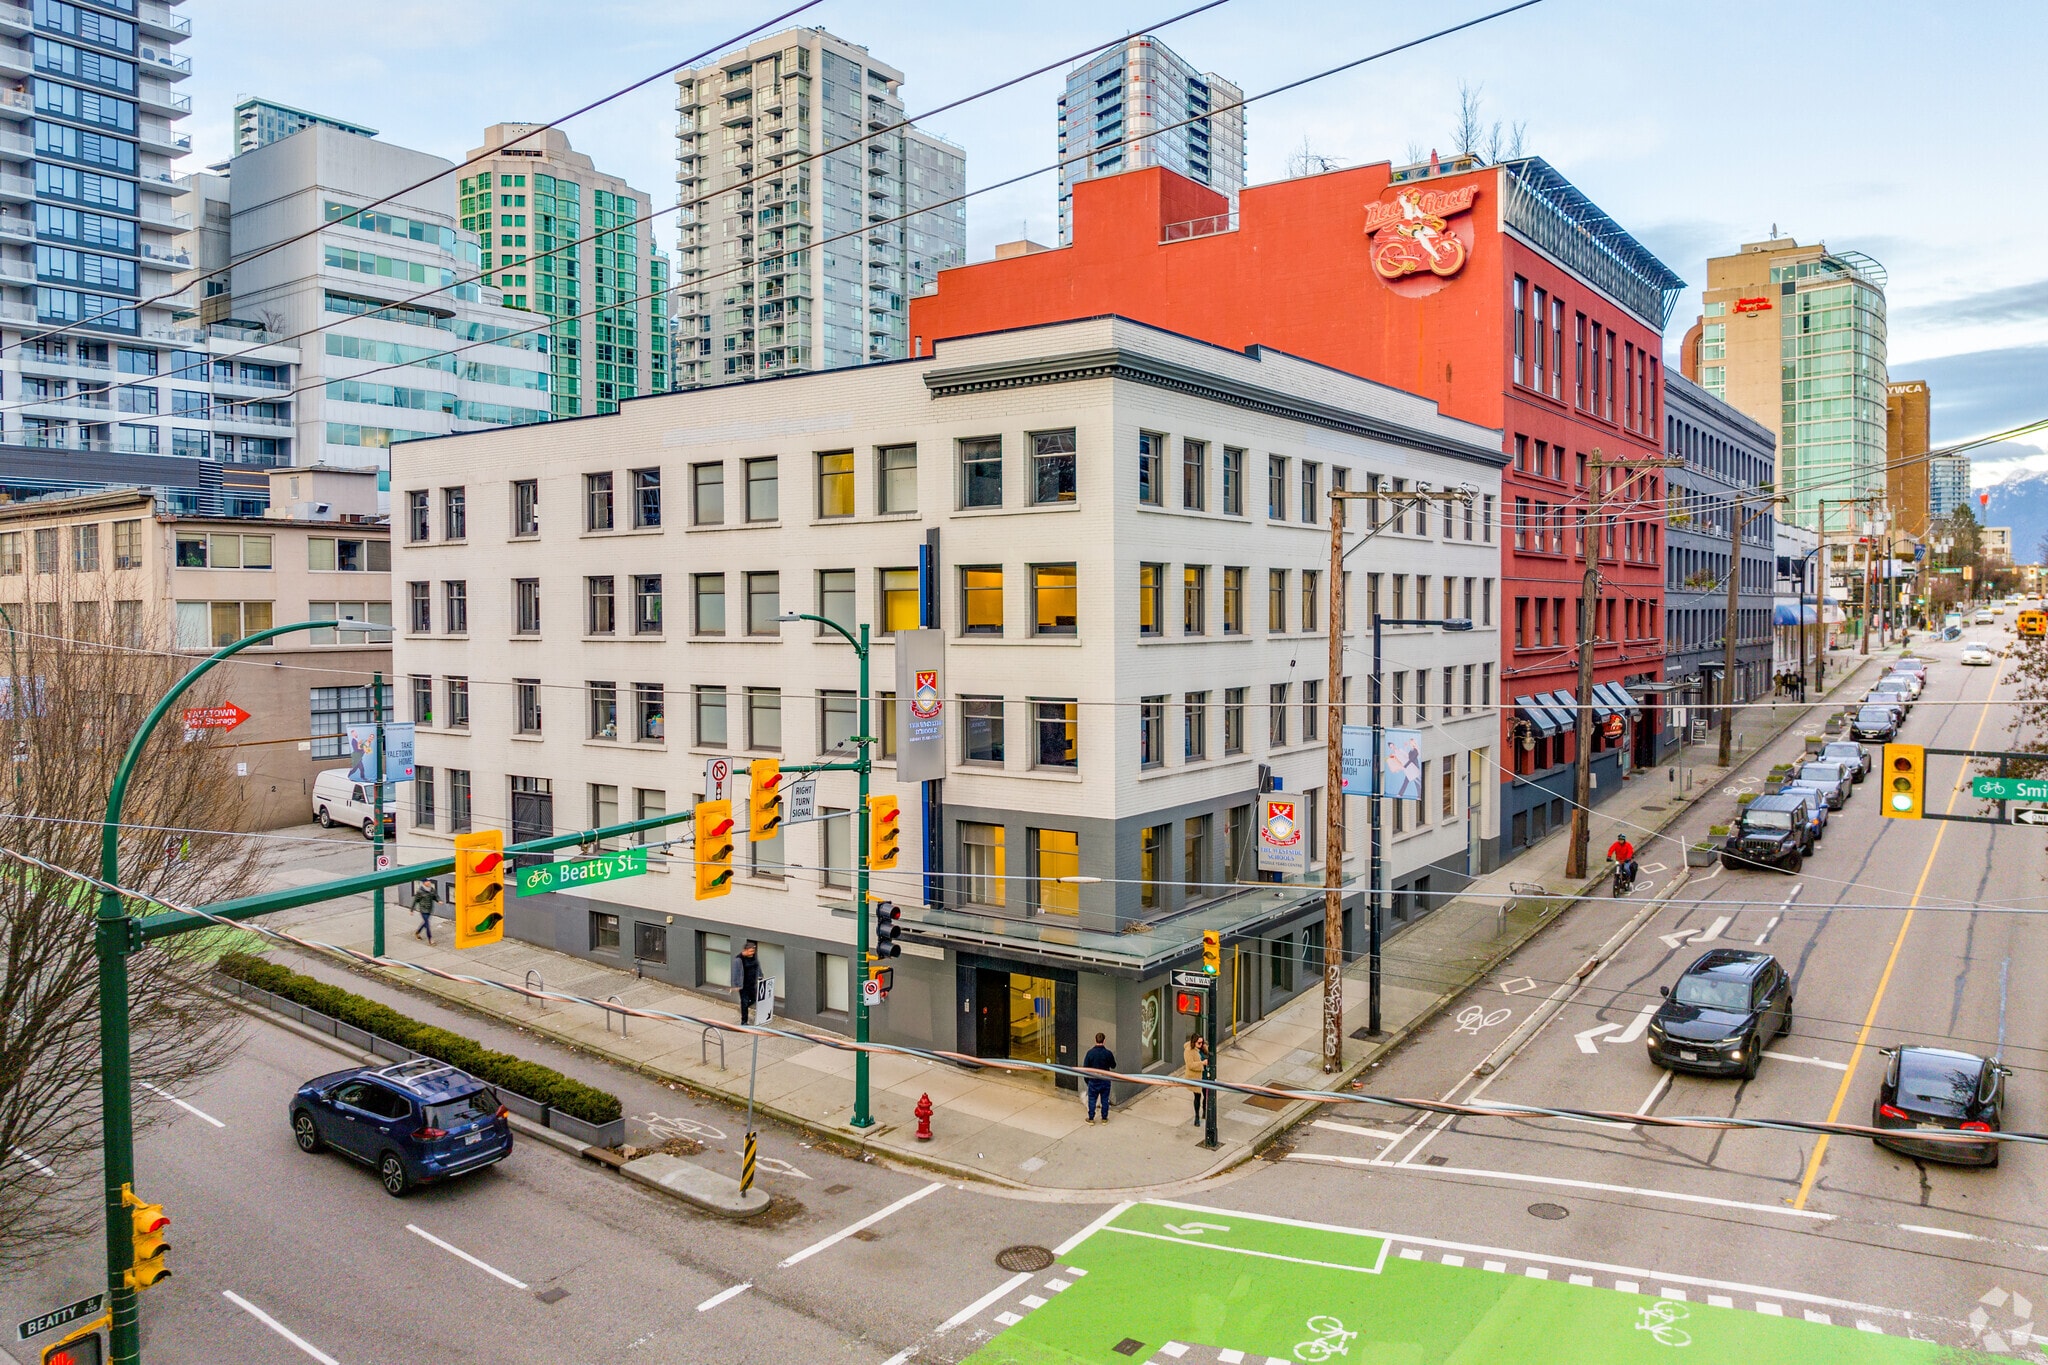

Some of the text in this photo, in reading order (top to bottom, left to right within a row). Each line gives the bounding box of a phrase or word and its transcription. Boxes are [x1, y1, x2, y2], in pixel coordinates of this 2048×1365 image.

[1421, 185, 1478, 214] Racer
[1887, 384, 1922, 394] YWCA
[187, 708, 237, 718] YALETOWN
[401, 741, 413, 749] TAKE
[387, 749, 413, 758] YALETOWN
[398, 757, 413, 765] HOME
[795, 786, 812, 795] RIGHT
[795, 797, 811, 806] TURN
[792, 808, 812, 818] SIGNAL
[560, 854, 639, 882] Beatty St.
[27, 1305, 78, 1335] BEATTY
